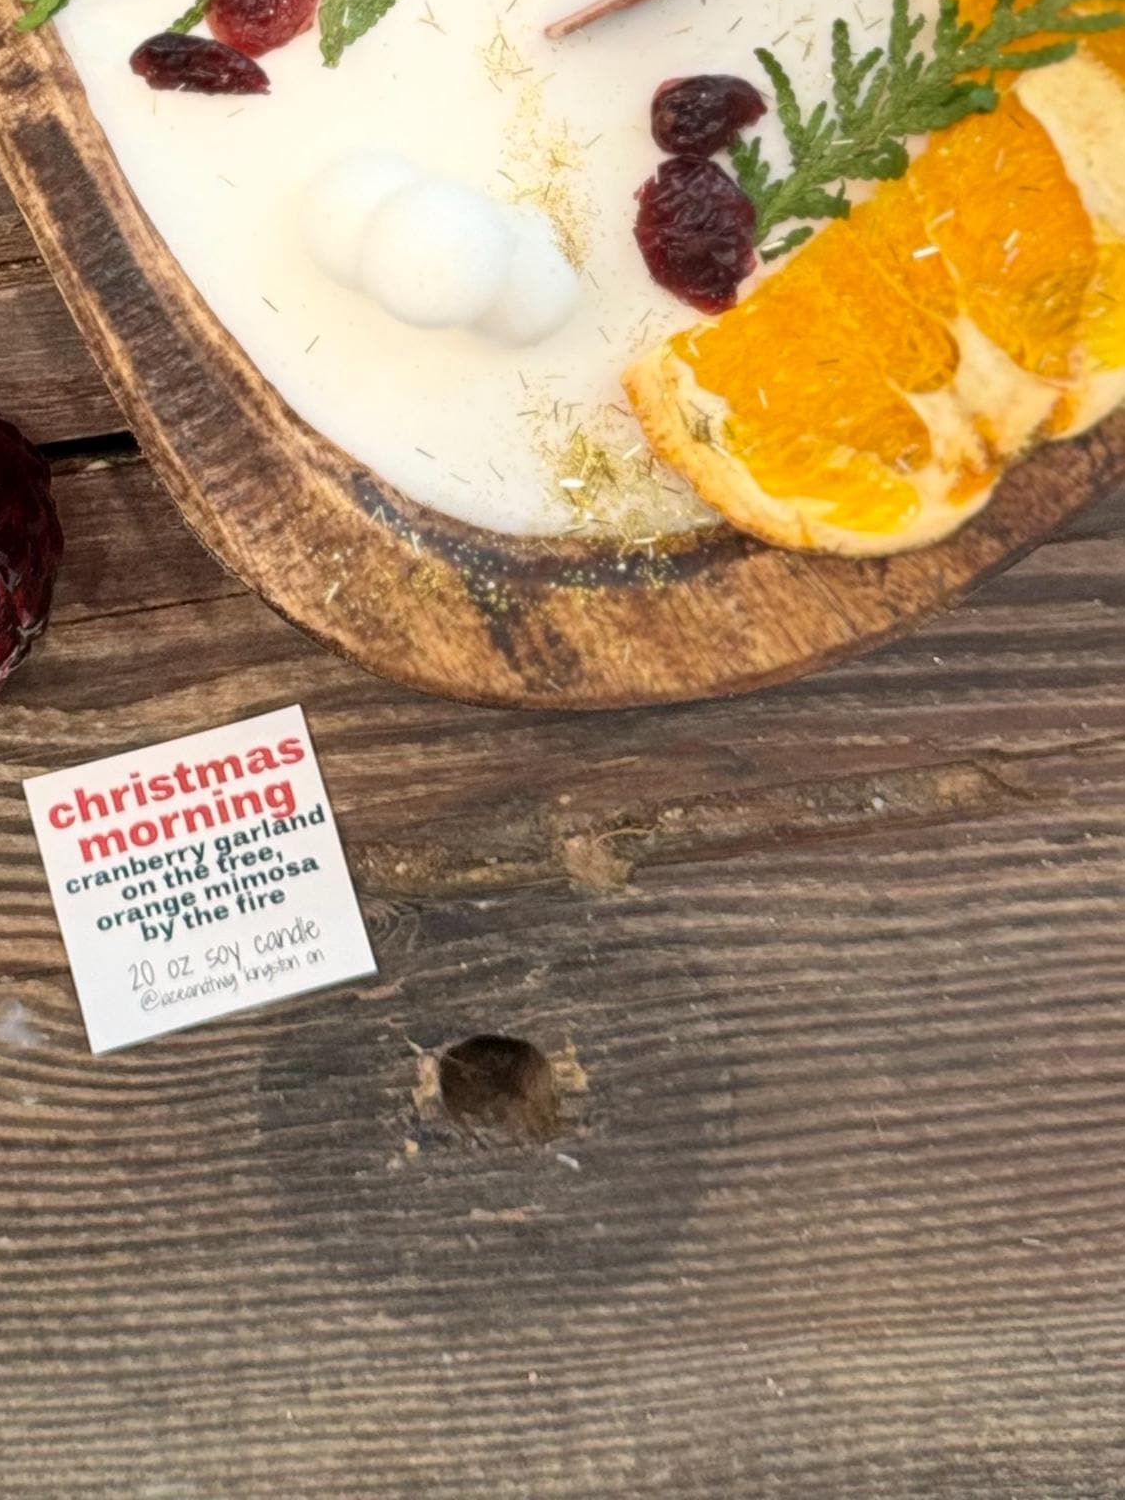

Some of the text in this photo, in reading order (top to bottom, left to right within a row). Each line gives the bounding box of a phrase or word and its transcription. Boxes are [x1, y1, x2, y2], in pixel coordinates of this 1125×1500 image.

[48, 736, 305, 830] christmas
[66, 804, 325, 895] cranberry garland
[78, 779, 296, 863] morning
[97, 856, 319, 931] orange mimosa
[121, 846, 283, 900] on the tree,
[141, 886, 285, 942] by the fire
[128, 916, 321, 991] 20 oz soy candle
[245, 953, 300, 983] kingston
[307, 948, 325, 965] on
